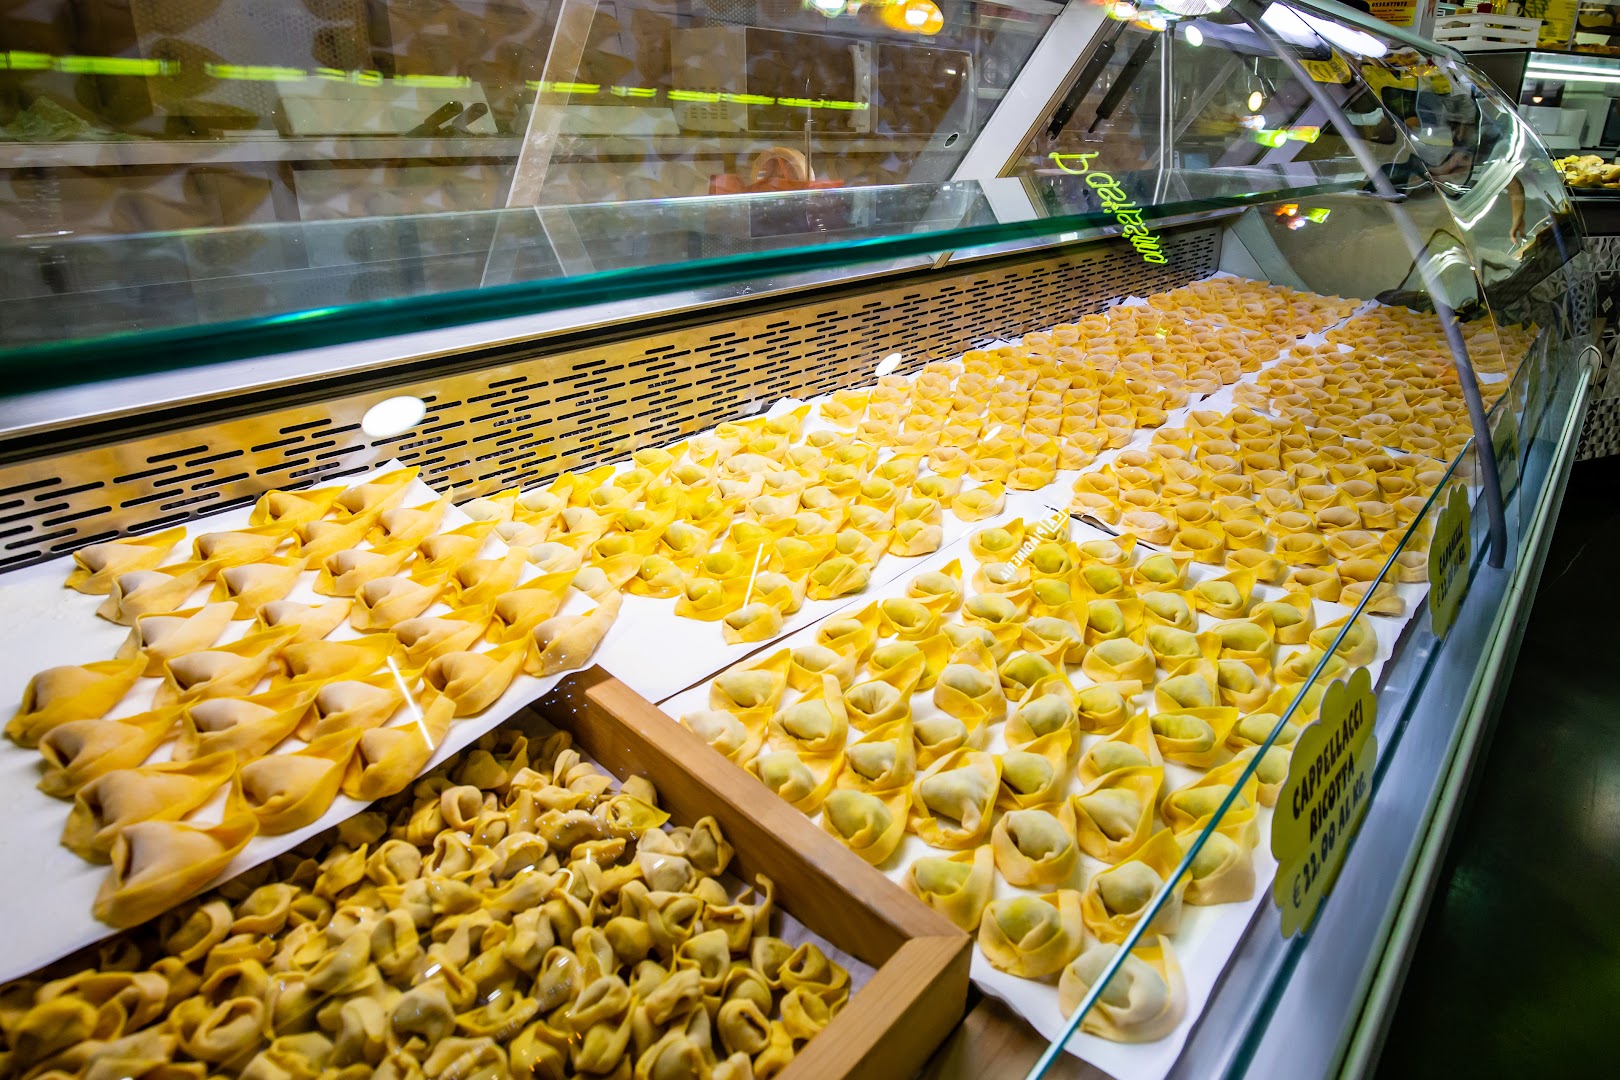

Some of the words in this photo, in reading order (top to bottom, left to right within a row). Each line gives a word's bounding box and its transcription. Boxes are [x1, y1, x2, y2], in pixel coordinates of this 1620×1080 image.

[1292, 698, 1364, 821] CAPPELLACCI
[1309, 751, 1355, 844] RICOTTA
[1292, 872, 1302, 910] €
[1337, 804, 1351, 837] AL
